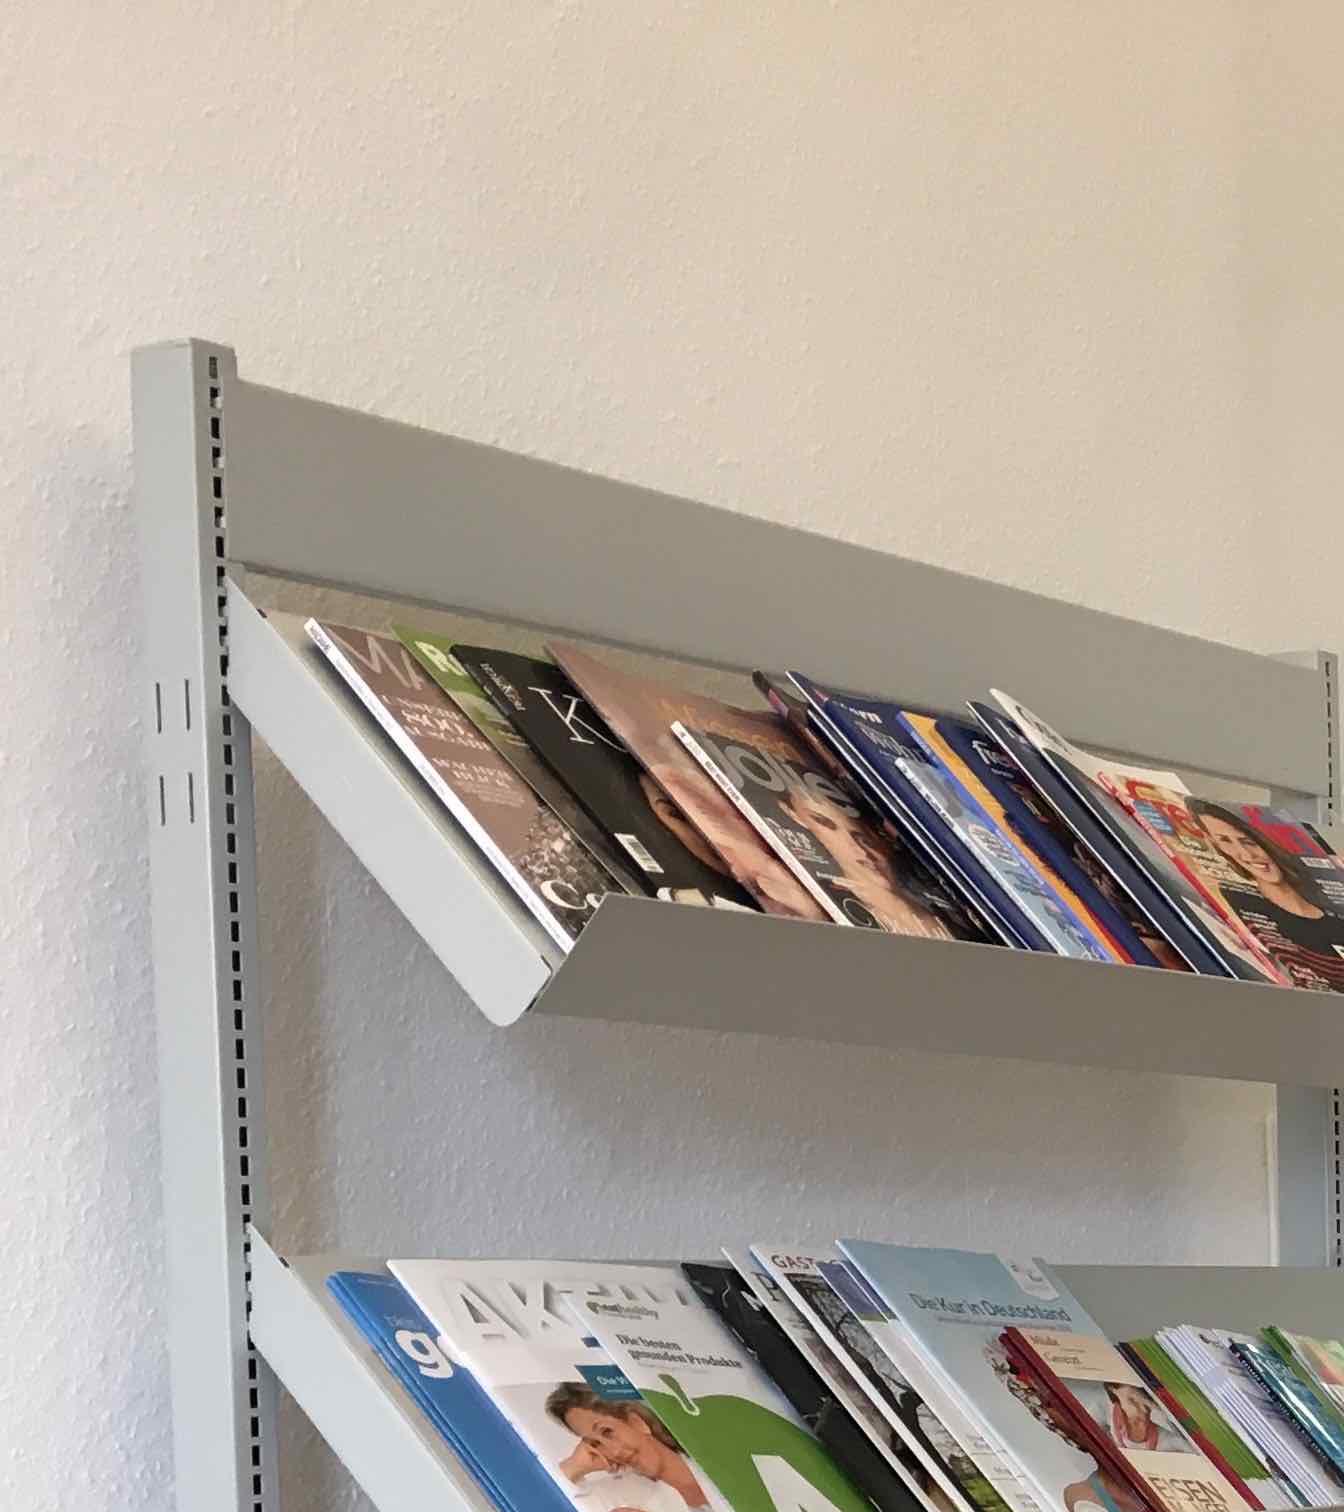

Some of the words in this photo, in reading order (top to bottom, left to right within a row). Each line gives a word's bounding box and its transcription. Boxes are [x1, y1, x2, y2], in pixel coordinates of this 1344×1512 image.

[981, 1300, 1073, 1322] Deutschland
[616, 1334, 640, 1346] Die
[641, 1335, 683, 1351] besten
[628, 1350, 687, 1365] gesunden
[687, 1353, 744, 1369] Produkte
